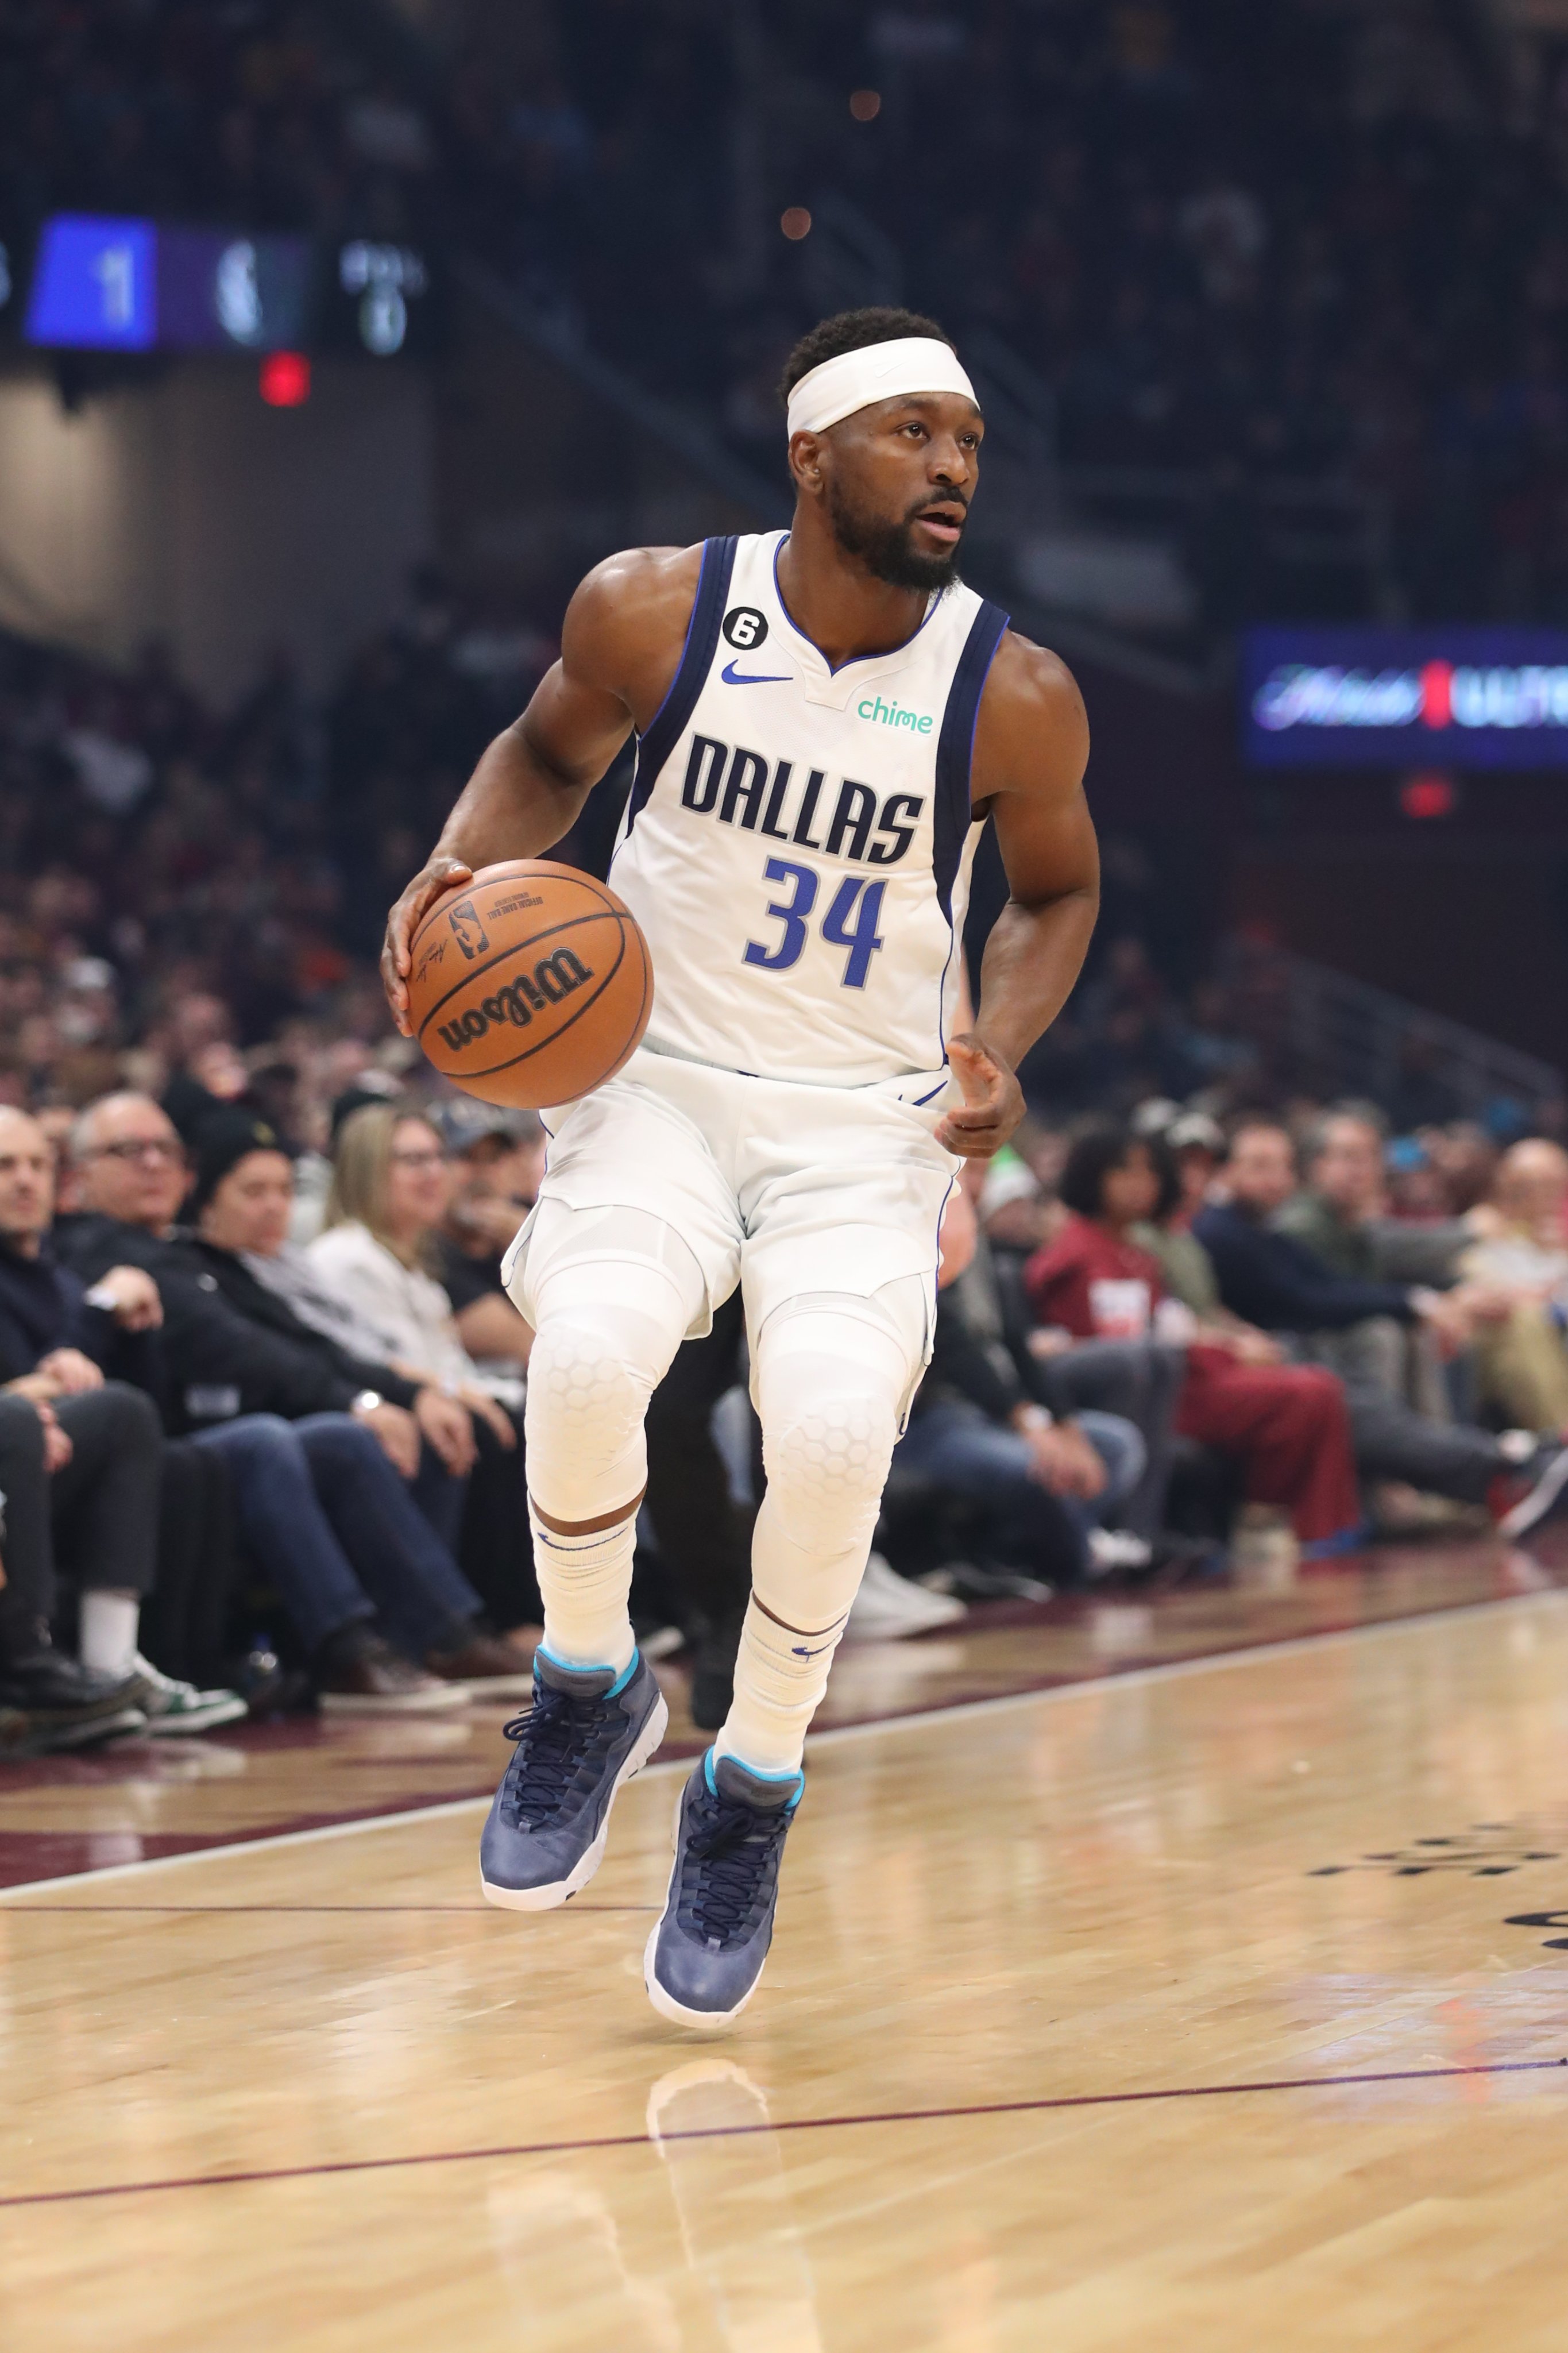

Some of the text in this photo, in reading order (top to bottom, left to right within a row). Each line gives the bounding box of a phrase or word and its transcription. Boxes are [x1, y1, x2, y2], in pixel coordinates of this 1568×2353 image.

[731, 612, 760, 645] 6
[858, 696, 933, 734] chime
[679, 731, 928, 866] DALLAS
[741, 855, 889, 991] 34
[437, 947, 594, 1052] Wilson
